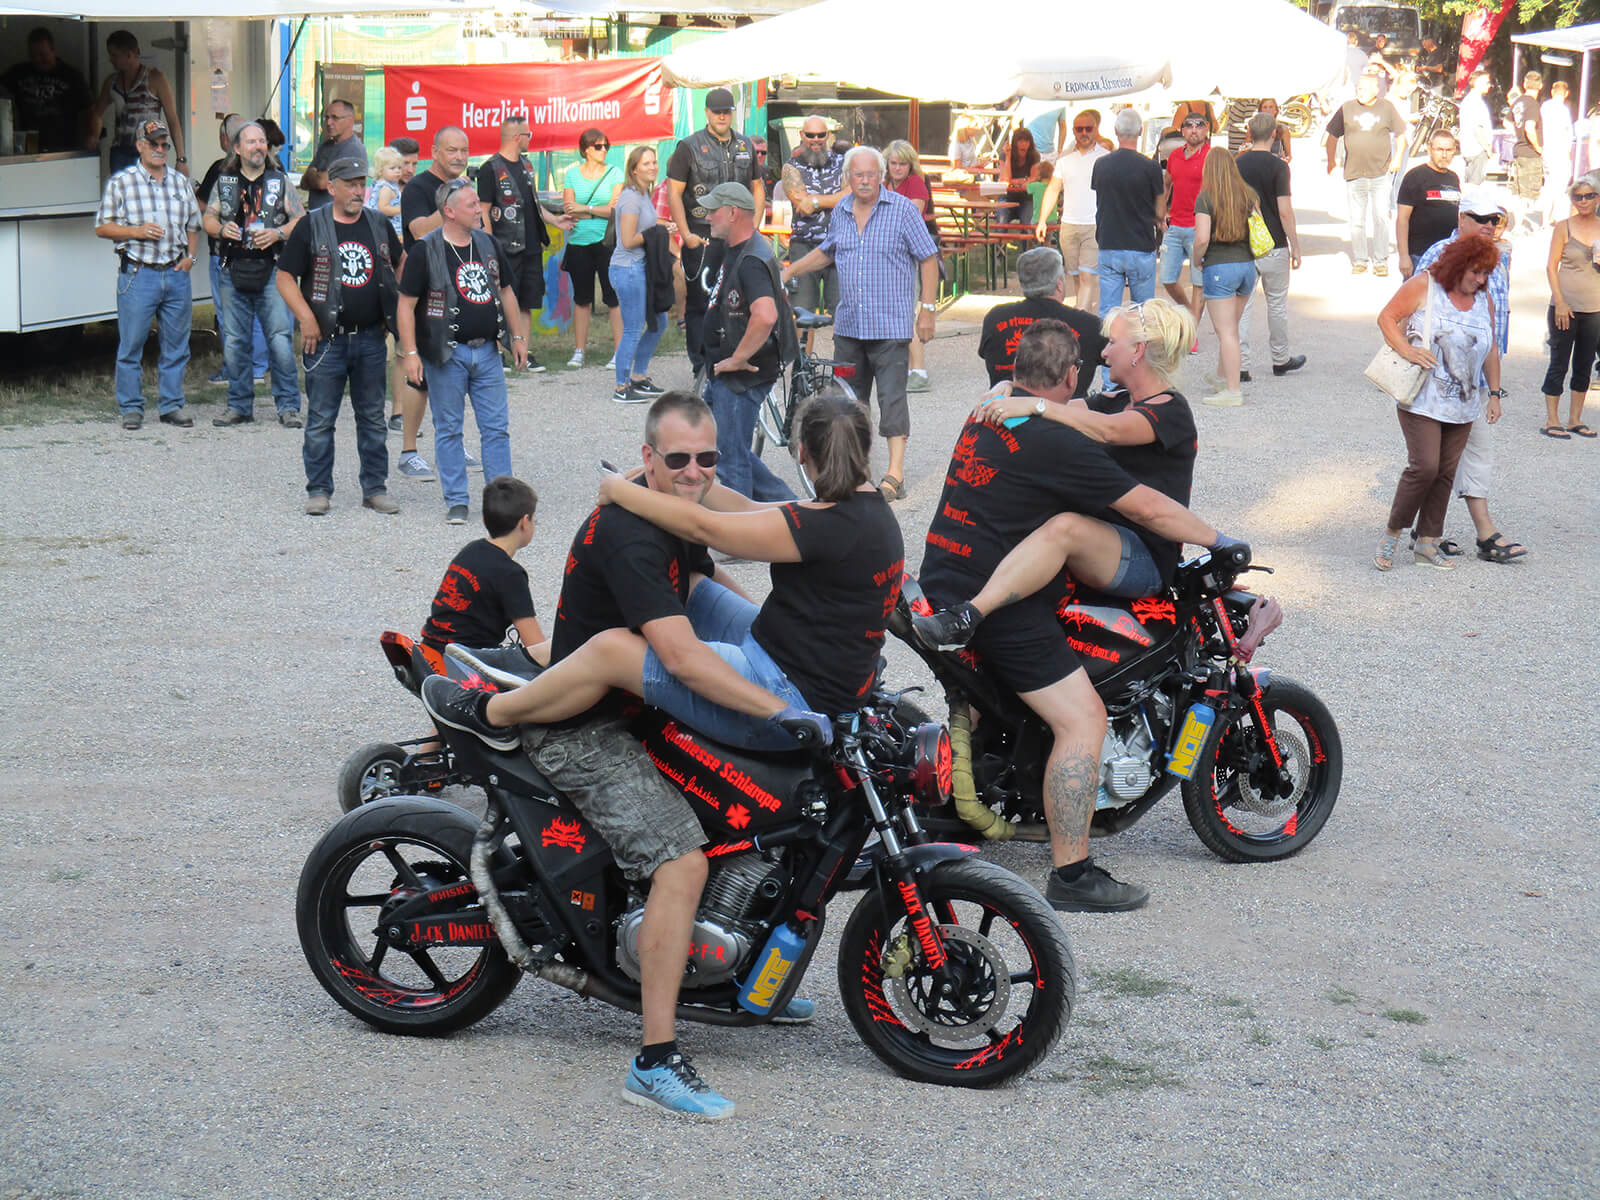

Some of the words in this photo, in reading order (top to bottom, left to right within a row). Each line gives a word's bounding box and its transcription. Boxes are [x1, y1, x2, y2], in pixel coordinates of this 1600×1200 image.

[1065, 82, 1101, 93] ERDINGER
[462, 99, 529, 128] Herzlich
[534, 97, 621, 125] willkommen
[1167, 710, 1207, 777] NOS
[719, 762, 782, 813] Schlampe
[898, 880, 924, 916] JACK
[411, 923, 444, 942] JCK
[747, 947, 793, 1008] NOS
